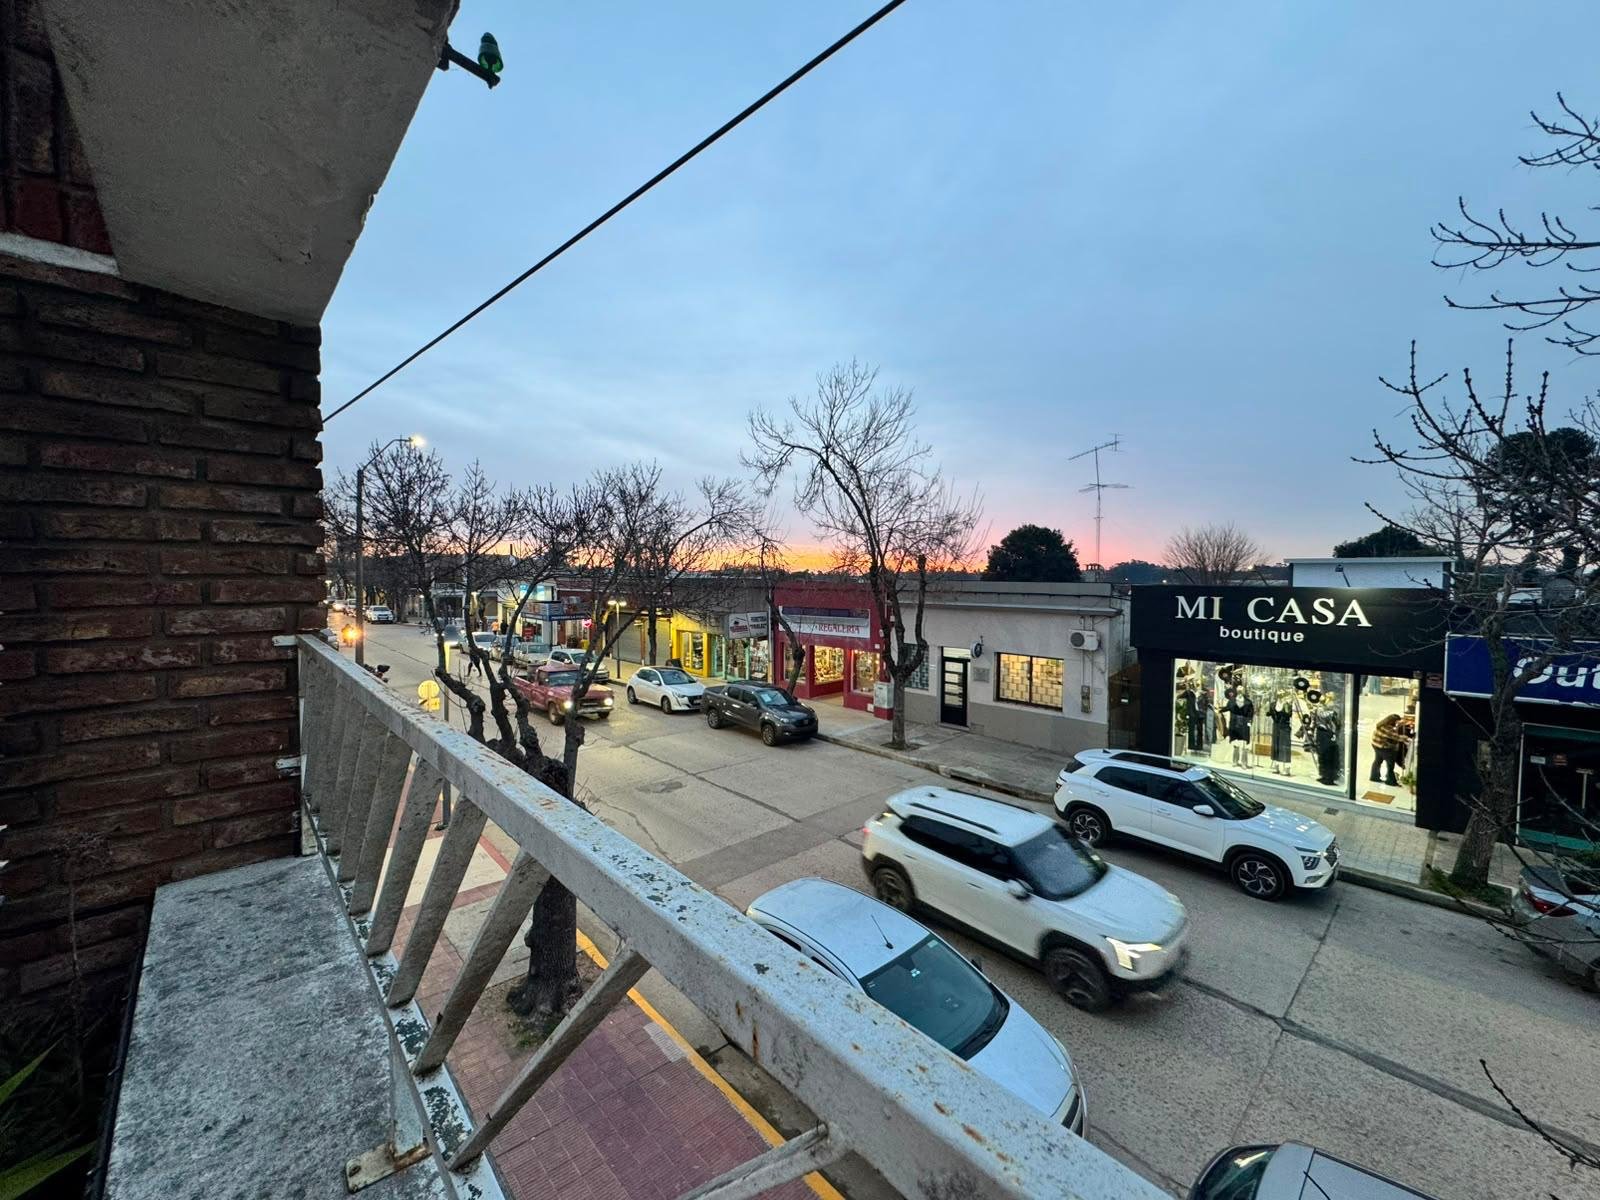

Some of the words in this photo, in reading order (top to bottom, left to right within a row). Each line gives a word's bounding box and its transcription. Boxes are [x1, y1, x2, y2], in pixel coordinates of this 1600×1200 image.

[1175, 595, 1224, 620] MI
[1247, 597, 1373, 627] CASA
[1219, 626, 1305, 643] boutique
